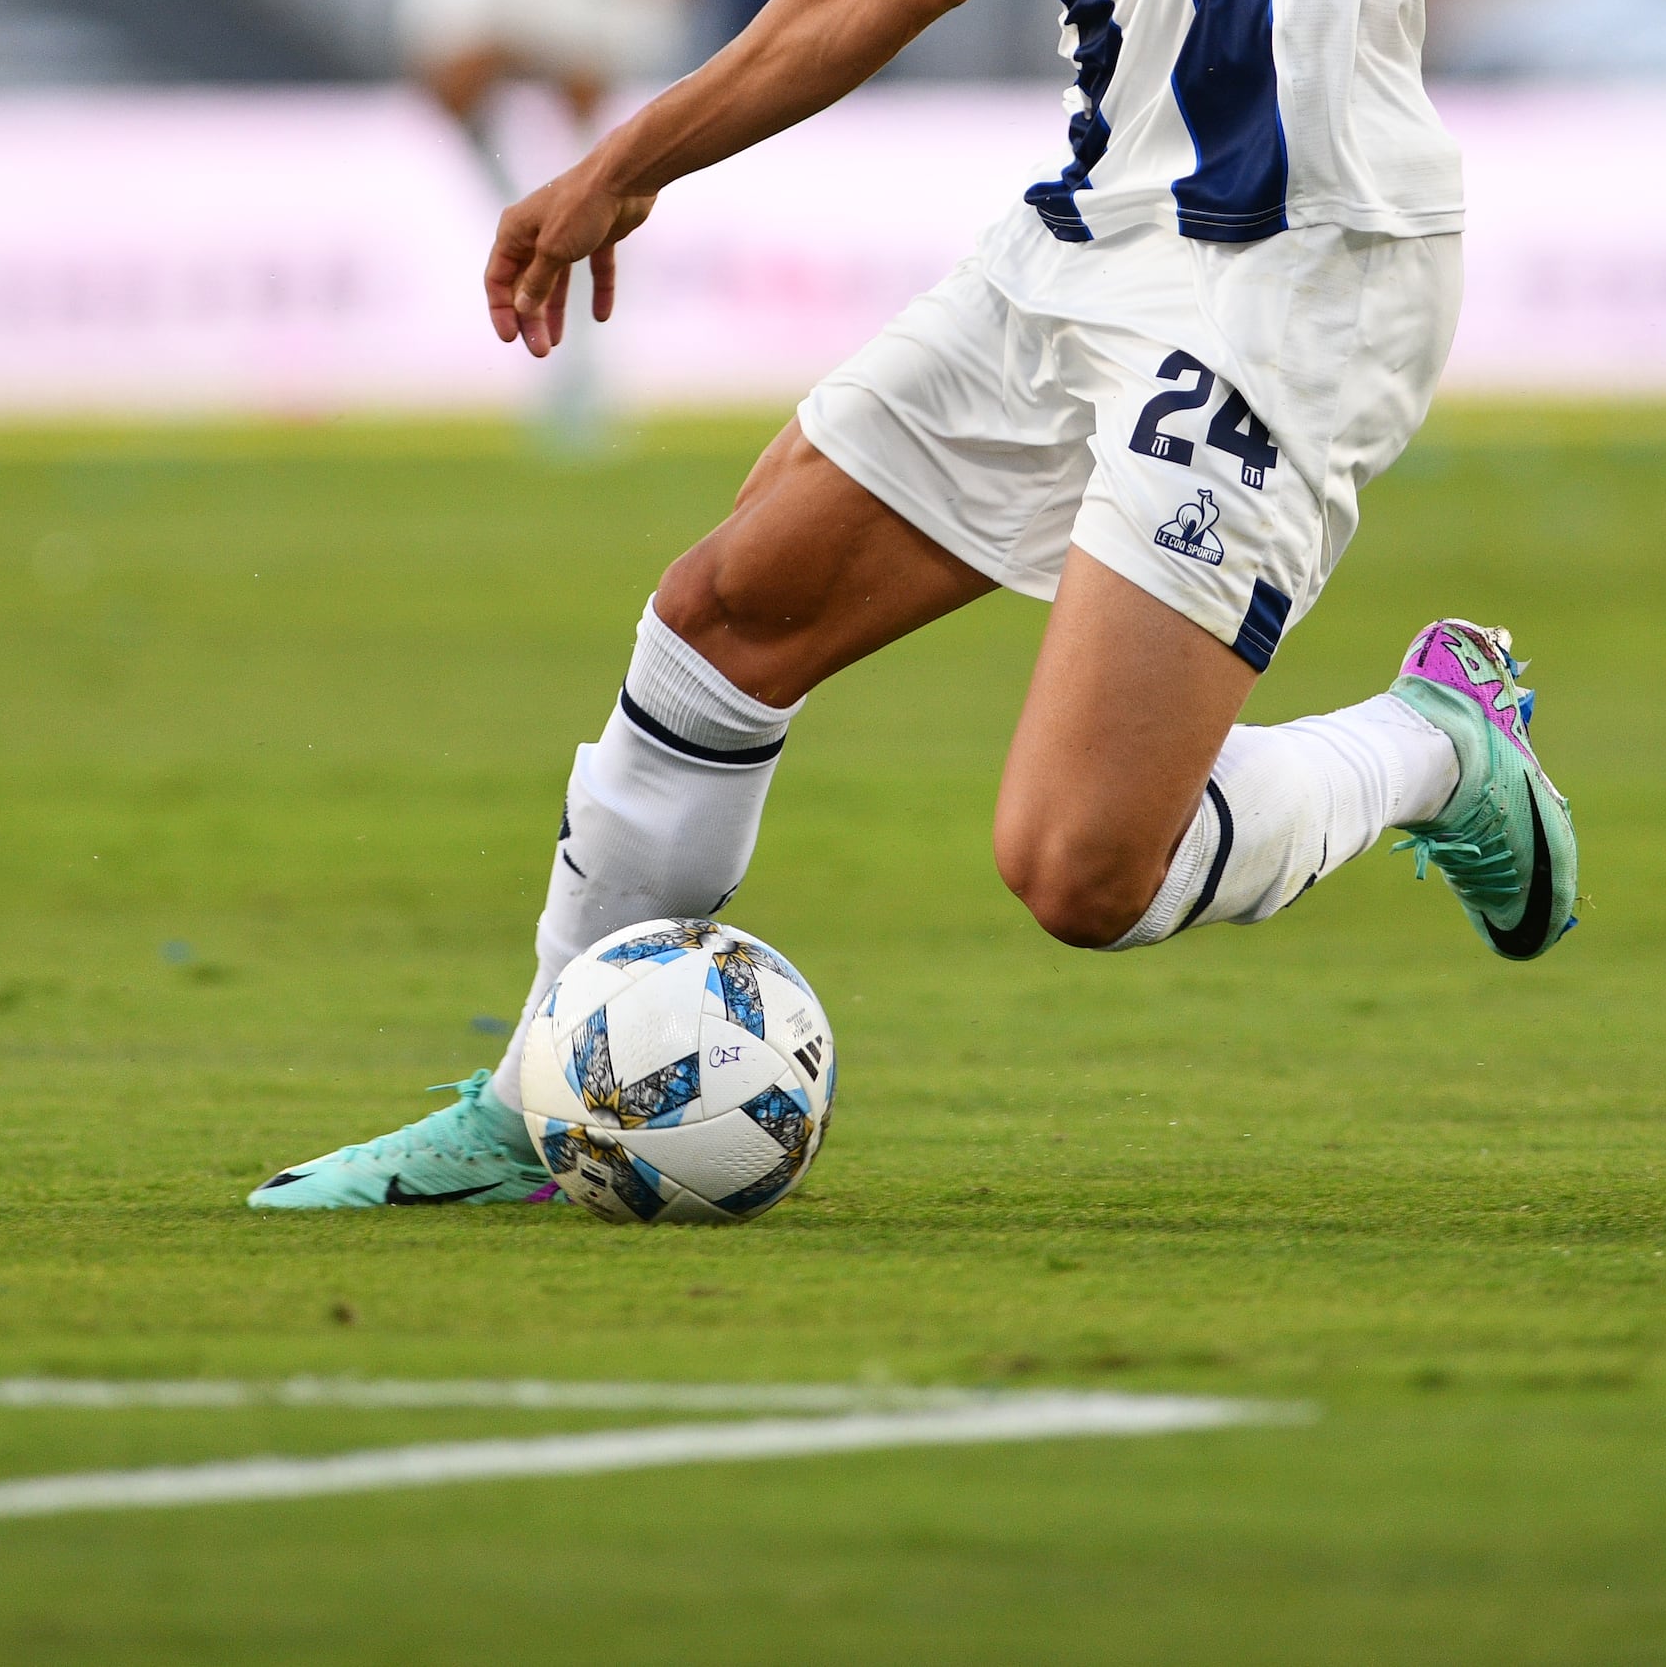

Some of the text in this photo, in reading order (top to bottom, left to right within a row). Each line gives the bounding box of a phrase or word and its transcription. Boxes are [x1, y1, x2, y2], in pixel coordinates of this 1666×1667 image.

[1128, 349, 1278, 491] 24
[1156, 531, 1222, 563] LE COQ SPORTIF
